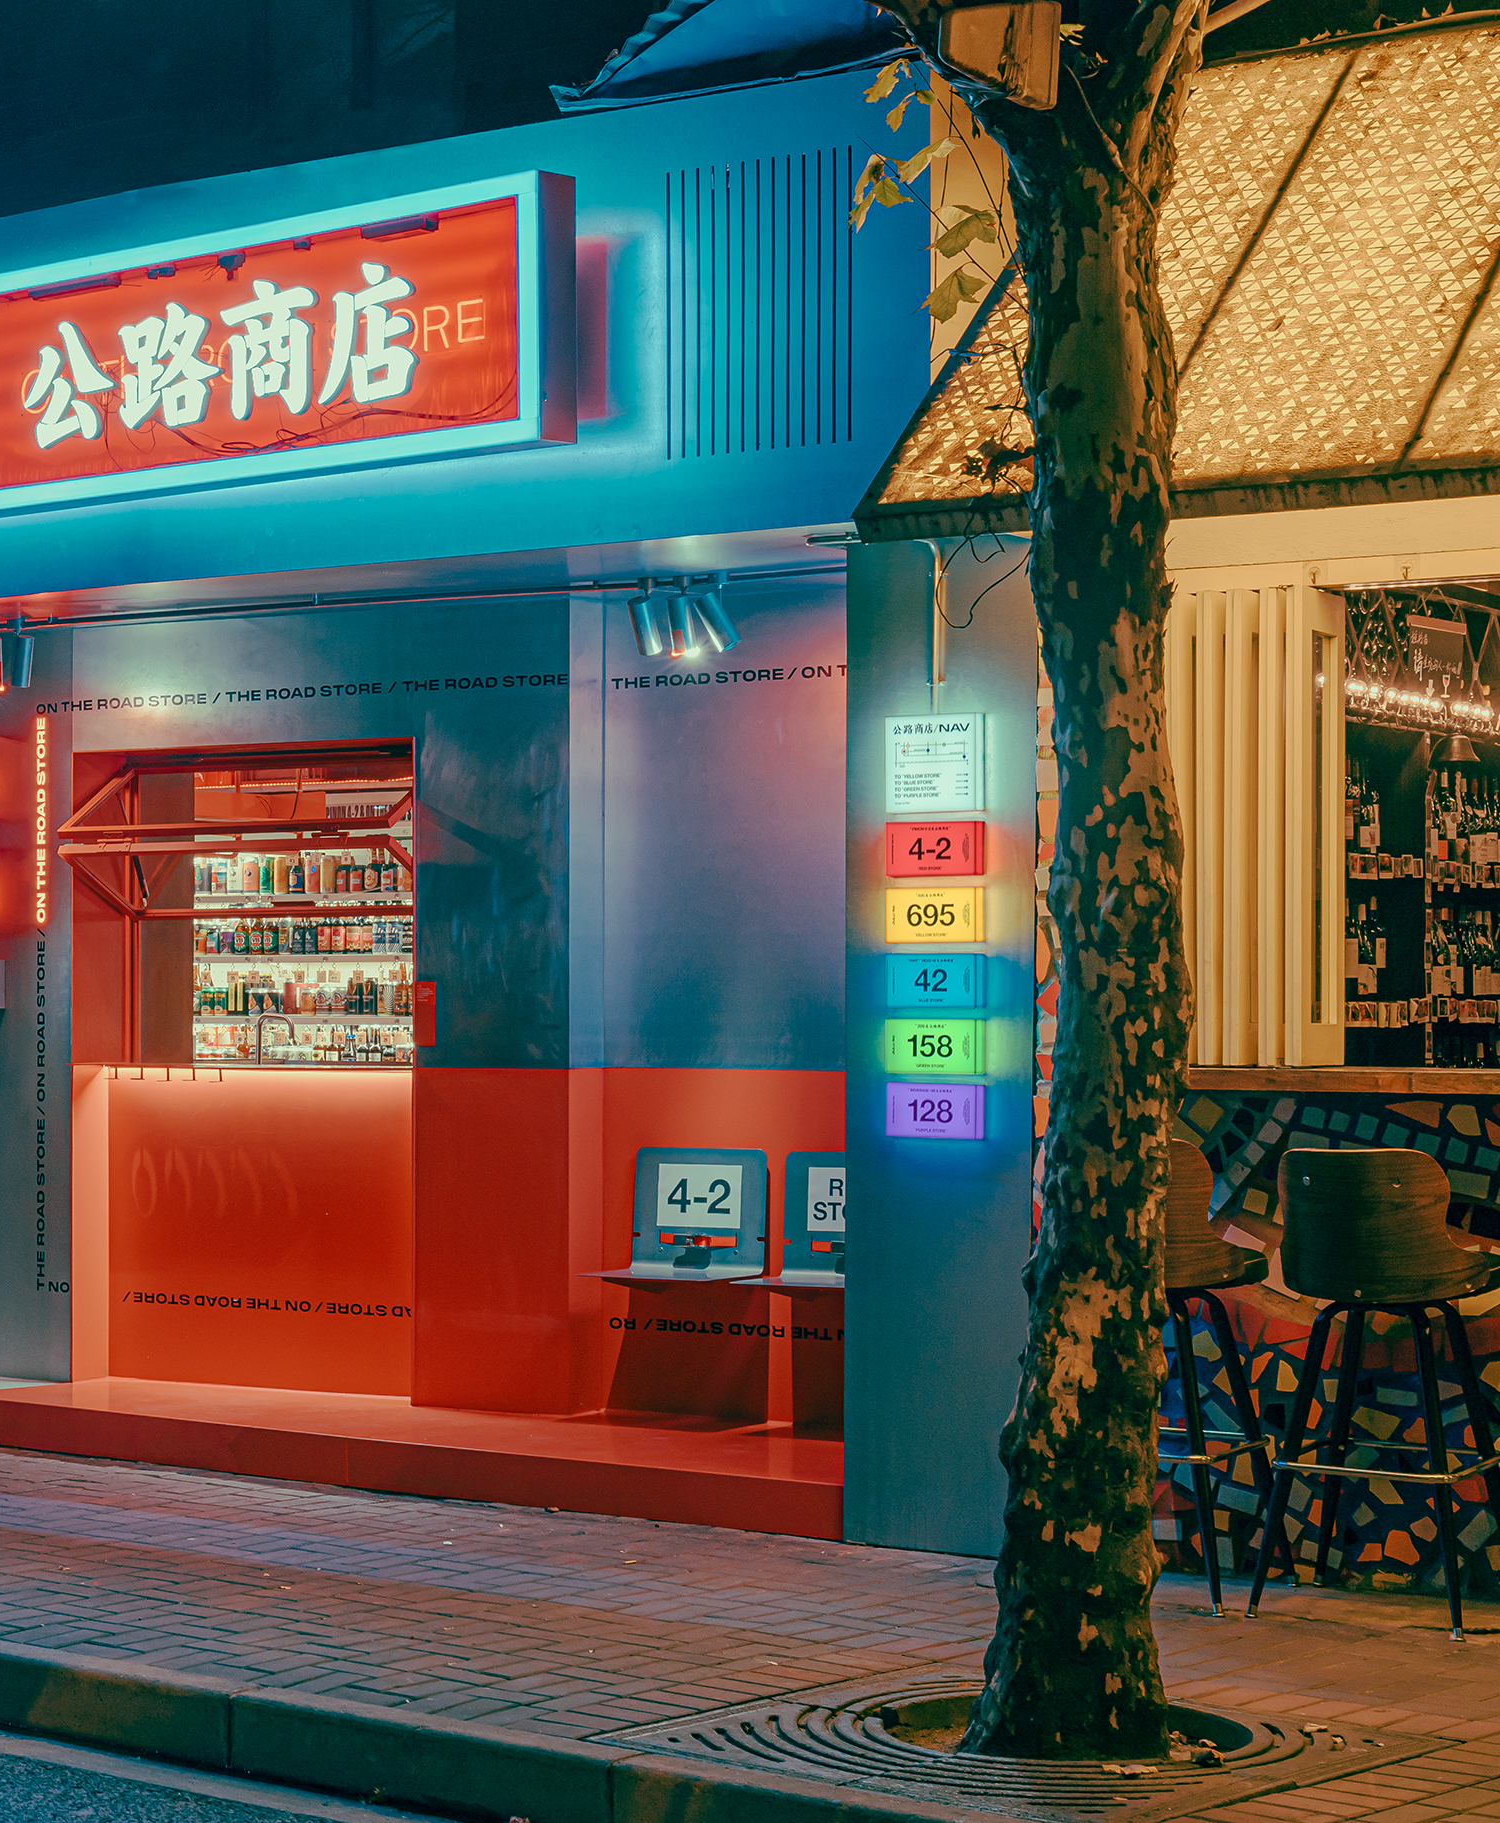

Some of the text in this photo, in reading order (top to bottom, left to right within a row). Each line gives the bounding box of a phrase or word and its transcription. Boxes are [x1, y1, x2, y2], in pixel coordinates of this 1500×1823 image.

[23, 262, 419, 450] 公路商店
[611, 676, 651, 690] THE
[655, 672, 712, 688] ROAD
[715, 668, 784, 684] STORE
[801, 665, 832, 679] ON
[36, 702, 58, 715] ON
[61, 700, 94, 713] THE
[97, 696, 145, 711] ROAD
[148, 692, 207, 708] STORE
[225, 690, 263, 703] THE
[266, 687, 317, 701] ROAD
[320, 682, 383, 698] STORE
[402, 678, 440, 693] THE
[444, 675, 499, 691] ROAD
[502, 673, 568, 689] STORE
[36, 717, 46, 924] ON THE ROAD STORE
[909, 837, 951, 860] 4-2
[907, 903, 955, 926] 695
[36, 940, 46, 1008] STORE
[914, 968, 947, 992] 42
[36, 1010, 46, 1070] ROAD
[907, 1034, 953, 1058] 158
[36, 1072, 46, 1103] ON
[908, 1099, 953, 1123] 128
[36, 1119, 46, 1187] STORE
[667, 1178, 731, 1214] 4-2
[36, 1188, 46, 1248] ROAD
[36, 1249, 46, 1292] THE
[133, 1291, 191, 1306] STORE
[194, 1295, 243, 1309] ROAD
[246, 1297, 282, 1311] THE
[326, 1301, 388, 1317] STORE
[656, 1318, 724, 1334] STORE
[728, 1323, 785, 1338] ROAD
[791, 1326, 833, 1341] THE
